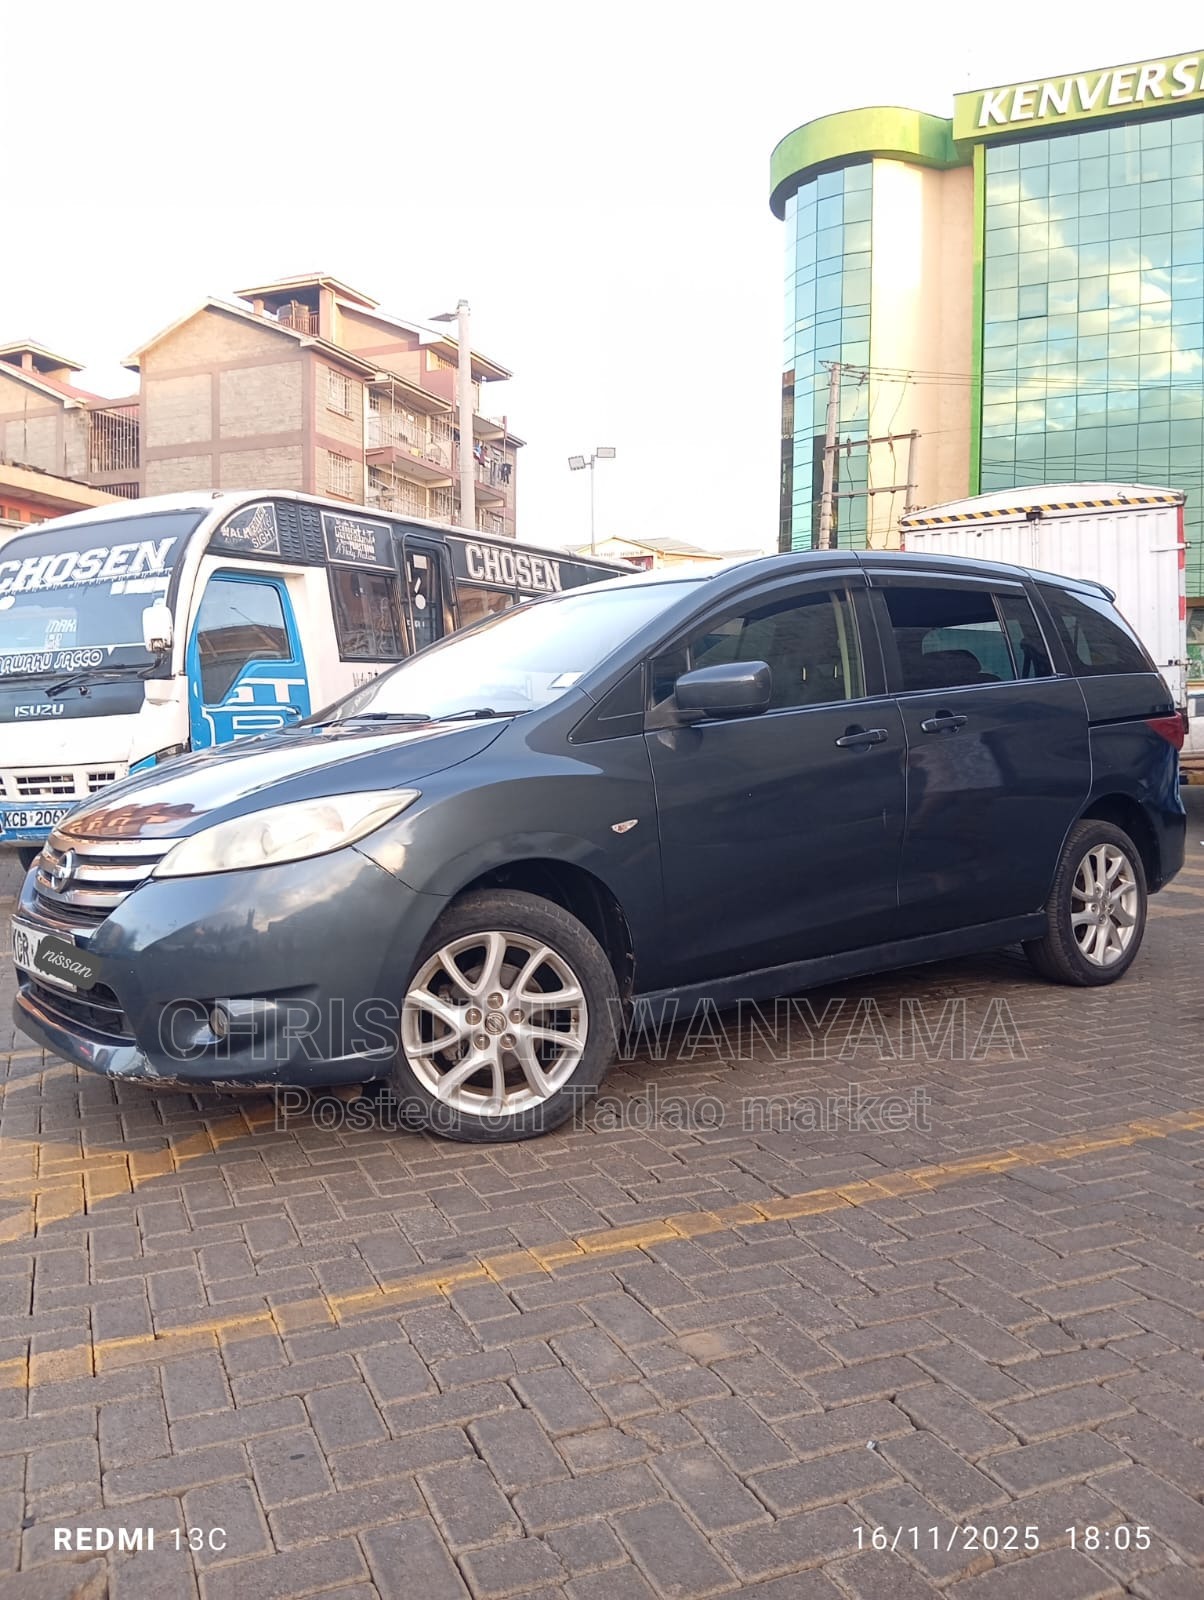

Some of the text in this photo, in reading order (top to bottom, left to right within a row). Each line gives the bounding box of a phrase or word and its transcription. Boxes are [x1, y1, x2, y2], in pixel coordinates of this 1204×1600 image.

[978, 57, 1204, 127] KENVERS
[252, 526, 276, 548] SIGHT
[0, 537, 178, 592] CHOSEN
[465, 543, 563, 592] CHOSEN
[54, 649, 103, 671] SACCO
[14, 703, 64, 717] ISUZU
[4, 811, 28, 827] KCB
